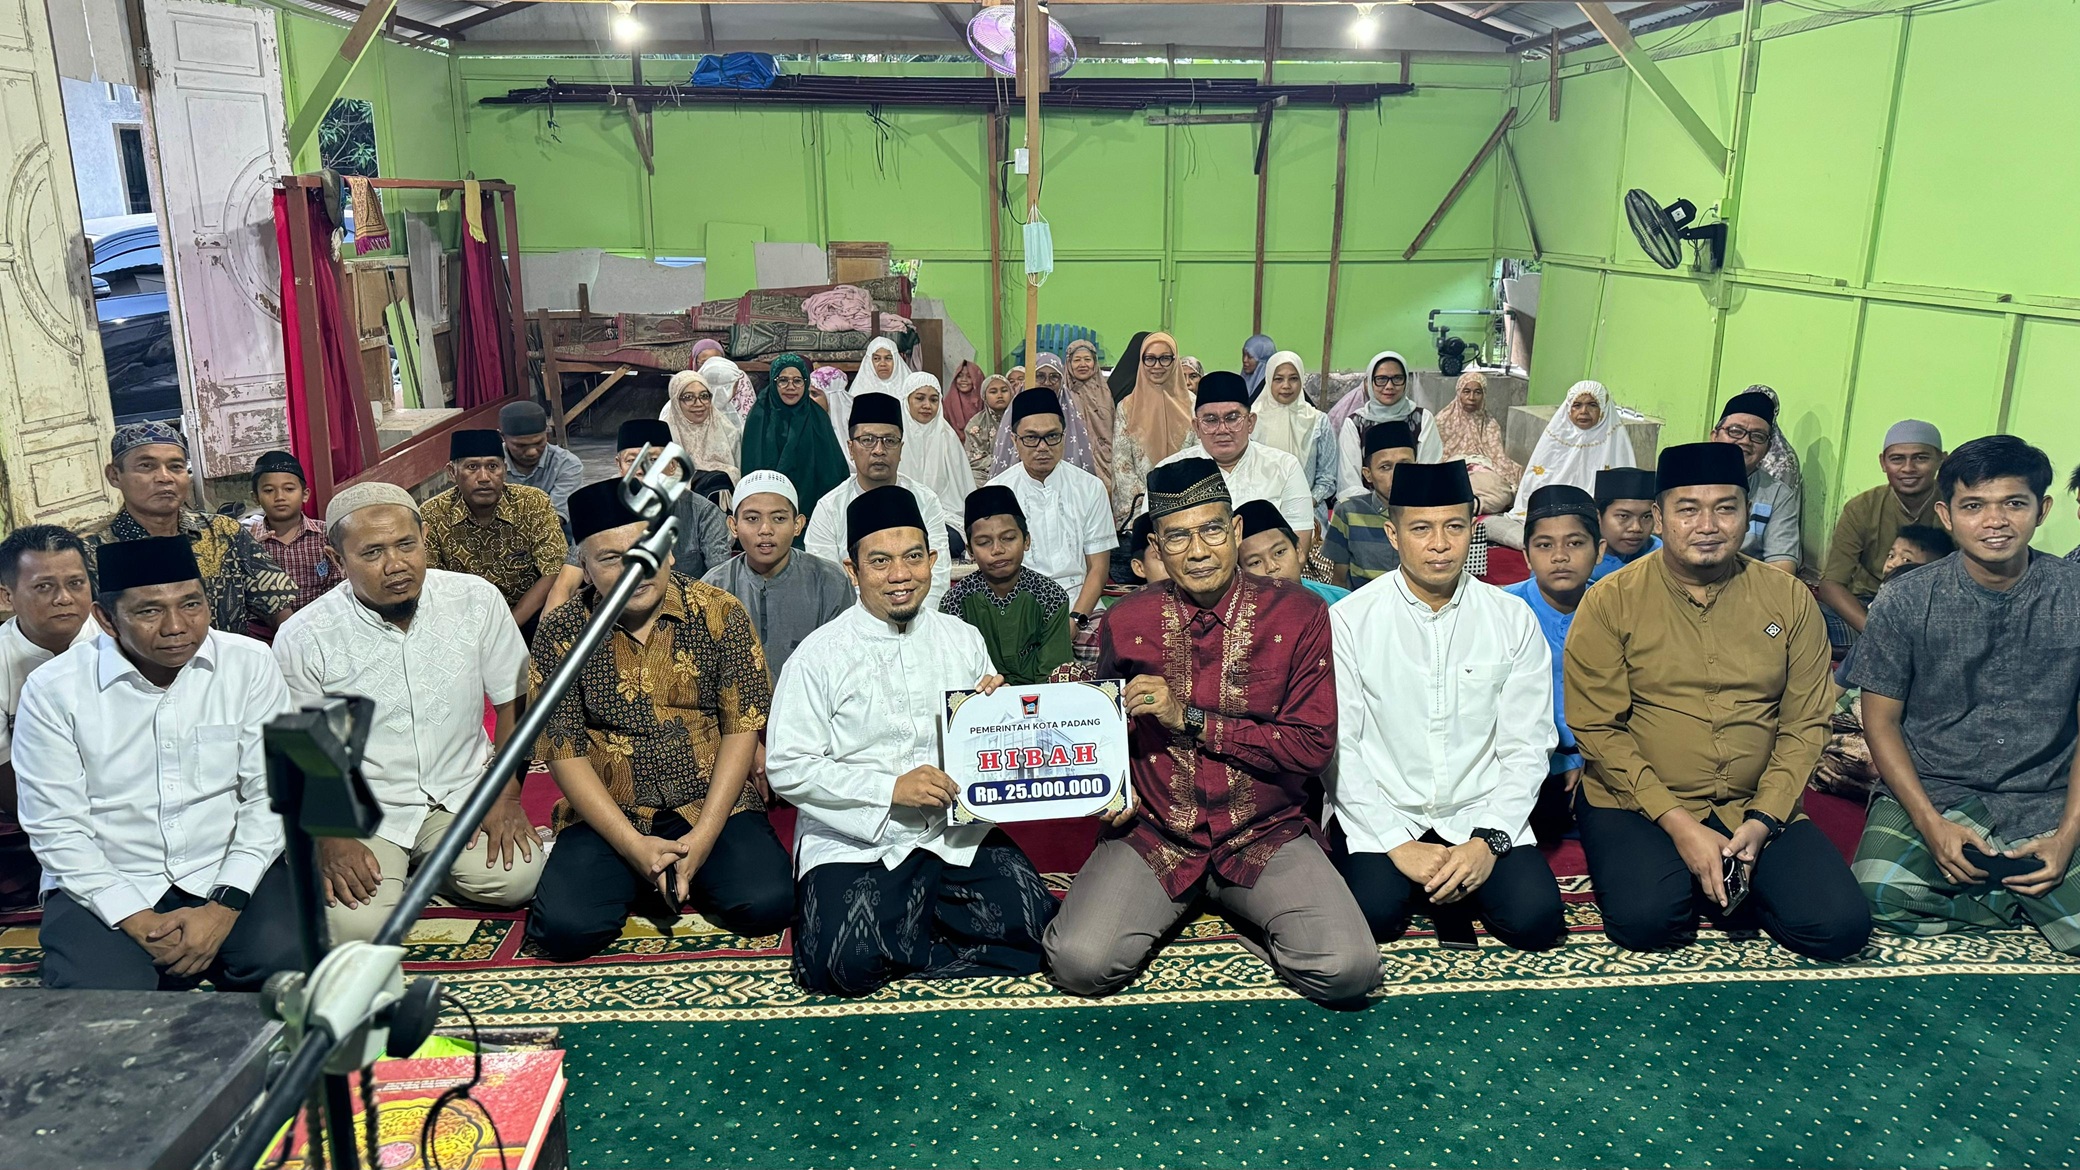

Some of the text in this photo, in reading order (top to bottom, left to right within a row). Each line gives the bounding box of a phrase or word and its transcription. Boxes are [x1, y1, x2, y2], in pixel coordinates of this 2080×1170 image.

[970, 718, 1101, 734] PEMERINTAH KOTA PADANG
[978, 743, 1097, 772] HIBAH
[975, 778, 1103, 803] Rp. 25.000.000
